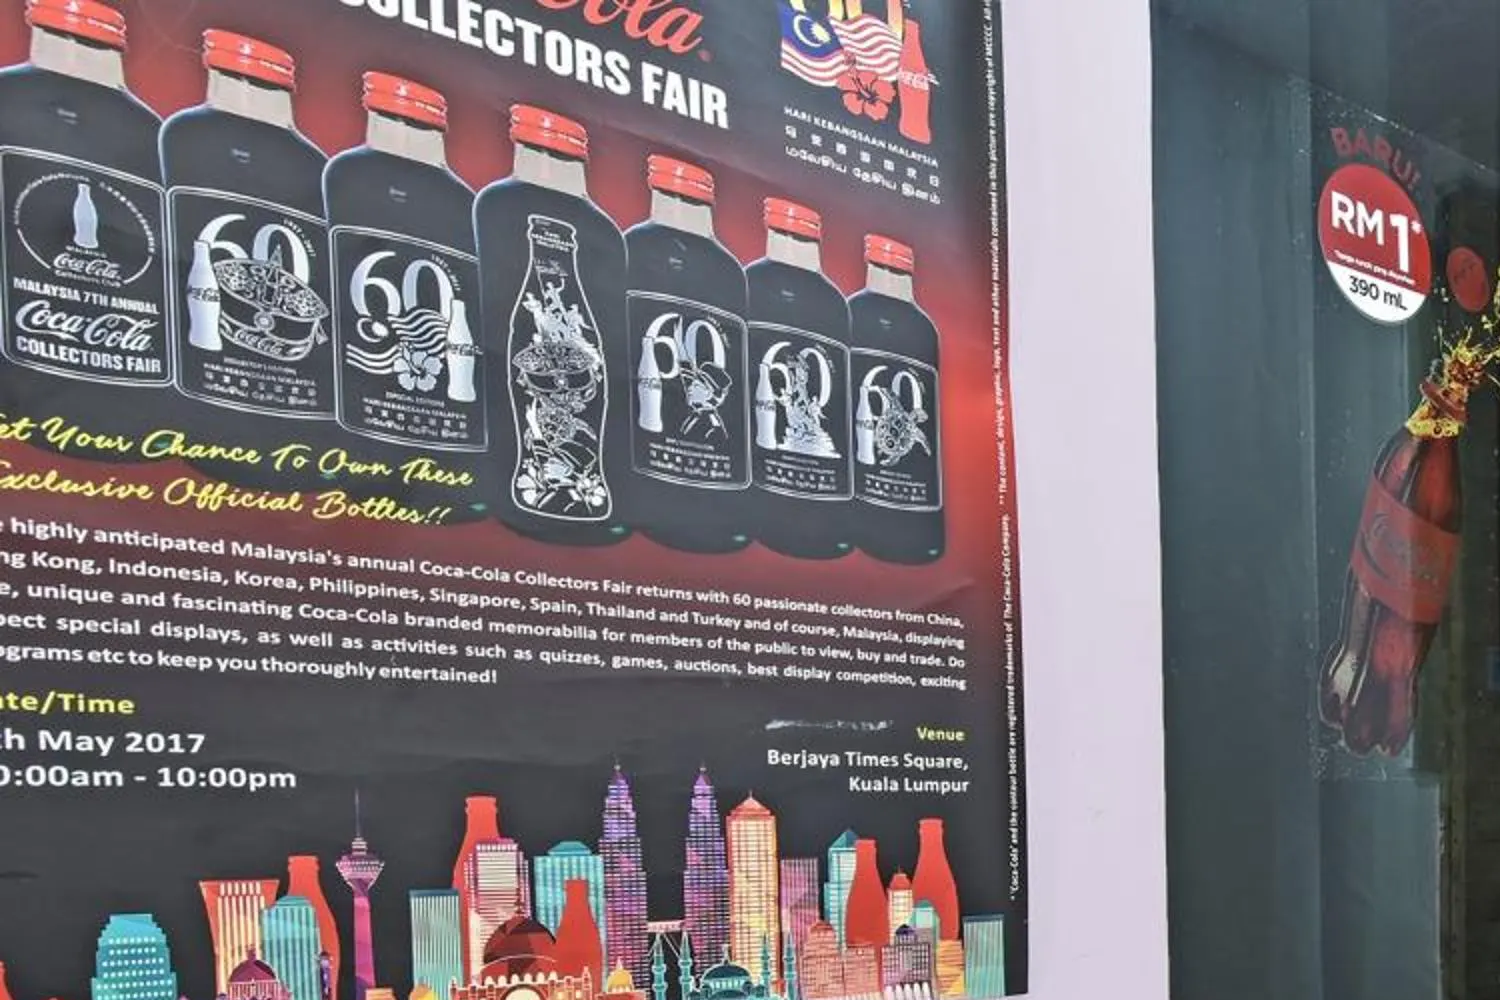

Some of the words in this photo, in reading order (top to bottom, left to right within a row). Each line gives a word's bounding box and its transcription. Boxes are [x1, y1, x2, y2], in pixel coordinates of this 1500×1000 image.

[338, 0, 633, 96] LLECTORS
[641, 60, 729, 129] FAIR
[784, 105, 811, 123] HARI
[1330, 127, 1421, 190] BARU!
[13, 277, 81, 302] MALAYSIA
[83, 291, 109, 306] 7TH
[110, 297, 160, 314] ANNUAL
[1349, 274, 1380, 301] 390
[1383, 290, 1408, 311] mL
[15, 300, 159, 351] Coca-Cola
[16, 336, 124, 371] COLLECTORS
[126, 356, 161, 373] FAIR
[0, 413, 37, 440] et
[41, 417, 131, 452] Your
[141, 429, 262, 465] Chance
[270, 443, 309, 471] To
[318, 449, 393, 477] Own
[399, 457, 474, 487] These
[163, 477, 304, 514] Official
[312, 491, 452, 526] Bottles!!
[11, 517, 88, 544] highly
[94, 527, 225, 556] anticipated
[230, 541, 342, 567] Malaysia's
[347, 556, 415, 574] annual
[419, 560, 510, 583] Coca-Cola
[514, 571, 599, 592] Collectors
[603, 579, 632, 595] Fair
[635, 583, 693, 601] returns
[696, 588, 730, 605] with
[732, 593, 751, 606] 60
[754, 596, 829, 616] passionate
[831, 604, 893, 621] collectors
[895, 609, 924, 623] from
[927, 613, 965, 629] China,
[32, 551, 102, 575] Kong,
[109, 558, 228, 587] Indonesia,
[235, 570, 305, 593] Korea,
[309, 577, 425, 603] Philippines,
[430, 588, 526, 612] Singapore,
[530, 598, 582, 617] Spain,
[586, 601, 654, 621] Thailand
[659, 607, 688, 623] and
[691, 611, 741, 630] Turkey
[744, 616, 771, 632] and
[773, 620, 789, 634] of
[791, 623, 841, 639] course,
[843, 626, 902, 645] Malaysia,
[905, 632, 965, 650] displaying
[27, 583, 114, 606] unique
[120, 590, 165, 608] and
[172, 593, 293, 620] fascinating
[299, 603, 398, 625] Coca-Cola
[404, 611, 483, 631] branded
[489, 620, 597, 641] memorabilia
[601, 627, 627, 642] for
[631, 630, 703, 650] members
[707, 635, 723, 649] of
[726, 637, 750, 652] the
[755, 640, 798, 658] public
[800, 645, 816, 657] to
[819, 646, 854, 662] view,
[857, 648, 881, 665] buy
[883, 651, 907, 664] and
[909, 654, 945, 667] trade.
[949, 656, 965, 669] Do
[56, 616, 140, 636] special
[150, 621, 248, 645] displays,
[258, 631, 281, 645] as
[290, 631, 333, 648] well
[341, 634, 364, 650] as
[371, 637, 458, 656] activities
[465, 644, 506, 659] such
[513, 647, 533, 661] as
[539, 648, 606, 668] quizzes,
[611, 653, 668, 671] games,
[674, 656, 742, 676] auctions,
[748, 661, 778, 677] best
[783, 665, 831, 682] display
[836, 669, 916, 687] competition,
[920, 675, 966, 690] exciting
[88, 650, 124, 665] etc
[129, 652, 153, 666] to
[157, 651, 212, 674] keep
[216, 657, 256, 673] you
[261, 656, 375, 681] thoroughly
[380, 667, 497, 684] entertained!
[0, 690, 136, 715] te/Time
[38, 729, 115, 756] May
[125, 732, 205, 753] 2017
[916, 726, 965, 741] Venue
[0, 765, 124, 788] 0:00am
[158, 767, 297, 792] 10:00pm
[767, 749, 840, 769] Berjaya
[846, 751, 899, 767] Times
[903, 753, 969, 771] Square,
[849, 777, 899, 792] Kuala
[904, 777, 969, 795] Lumpur
[1008, 827, 1018, 843] and
